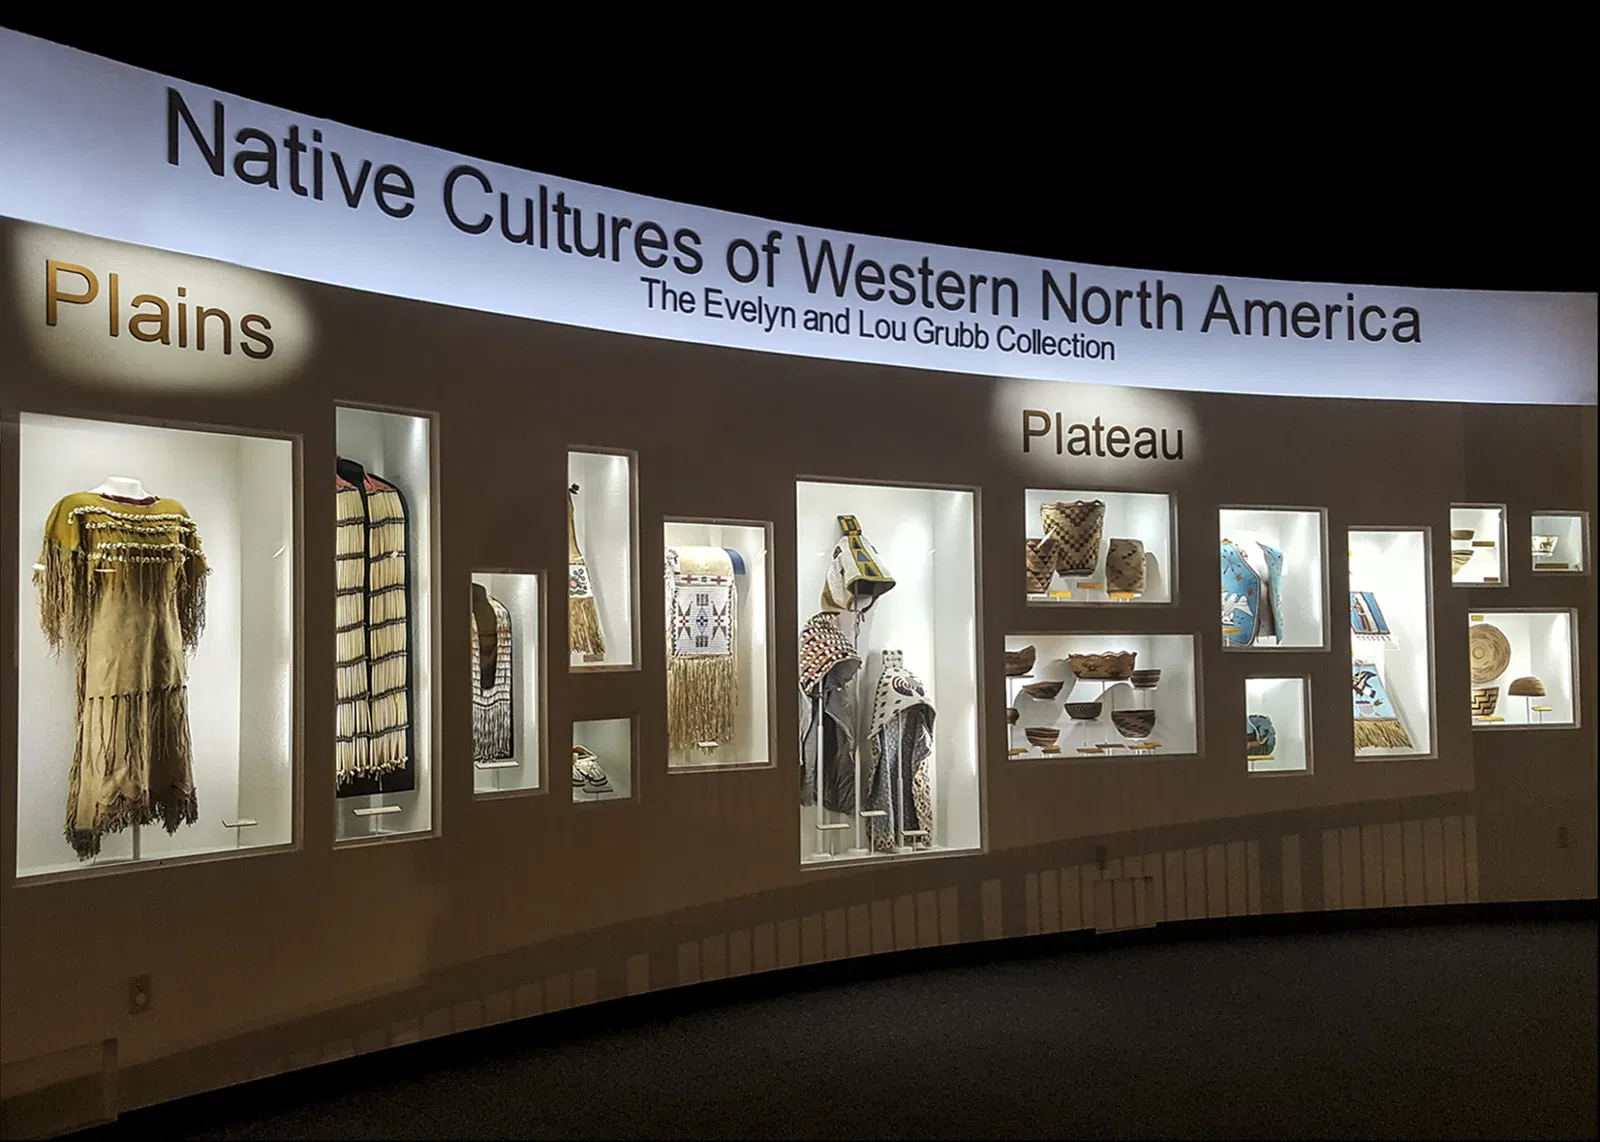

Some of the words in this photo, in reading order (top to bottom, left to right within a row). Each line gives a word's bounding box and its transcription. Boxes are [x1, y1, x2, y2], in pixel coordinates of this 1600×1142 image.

[167, 87, 416, 219] Native
[442, 163, 704, 275] Cultures
[725, 229, 784, 289] of
[795, 234, 1019, 318] Western
[1041, 268, 1184, 332] North
[1199, 278, 1422, 344] America
[46, 259, 275, 359] Plains
[639, 276, 696, 314] The
[703, 286, 797, 333] Evelyn
[803, 309, 850, 335] and
[858, 309, 907, 342] Lou
[912, 316, 990, 351] Grubb
[996, 323, 1115, 361] Collection
[1022, 409, 1184, 461] Plateau
